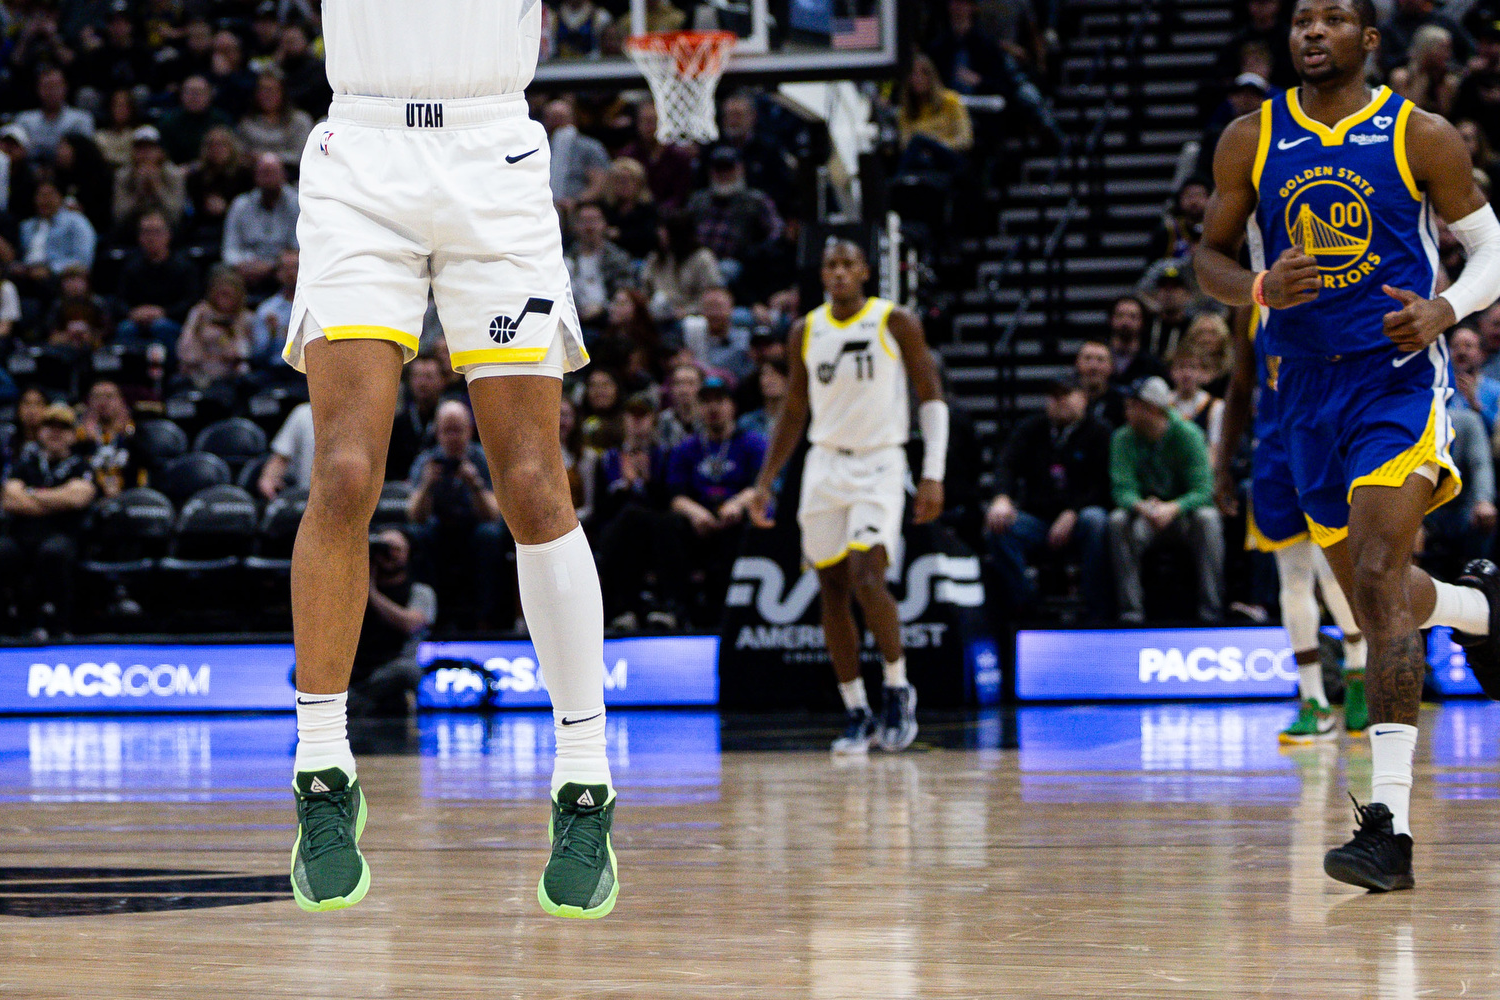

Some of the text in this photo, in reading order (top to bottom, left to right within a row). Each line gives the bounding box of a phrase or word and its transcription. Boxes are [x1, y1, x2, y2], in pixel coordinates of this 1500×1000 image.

[405, 102, 444, 128] UTAH
[1279, 165, 1376, 198] GOLDEN STATE
[1329, 201, 1363, 229] 00
[854, 353, 874, 381] 11
[27, 662, 211, 698] PACS.COM
